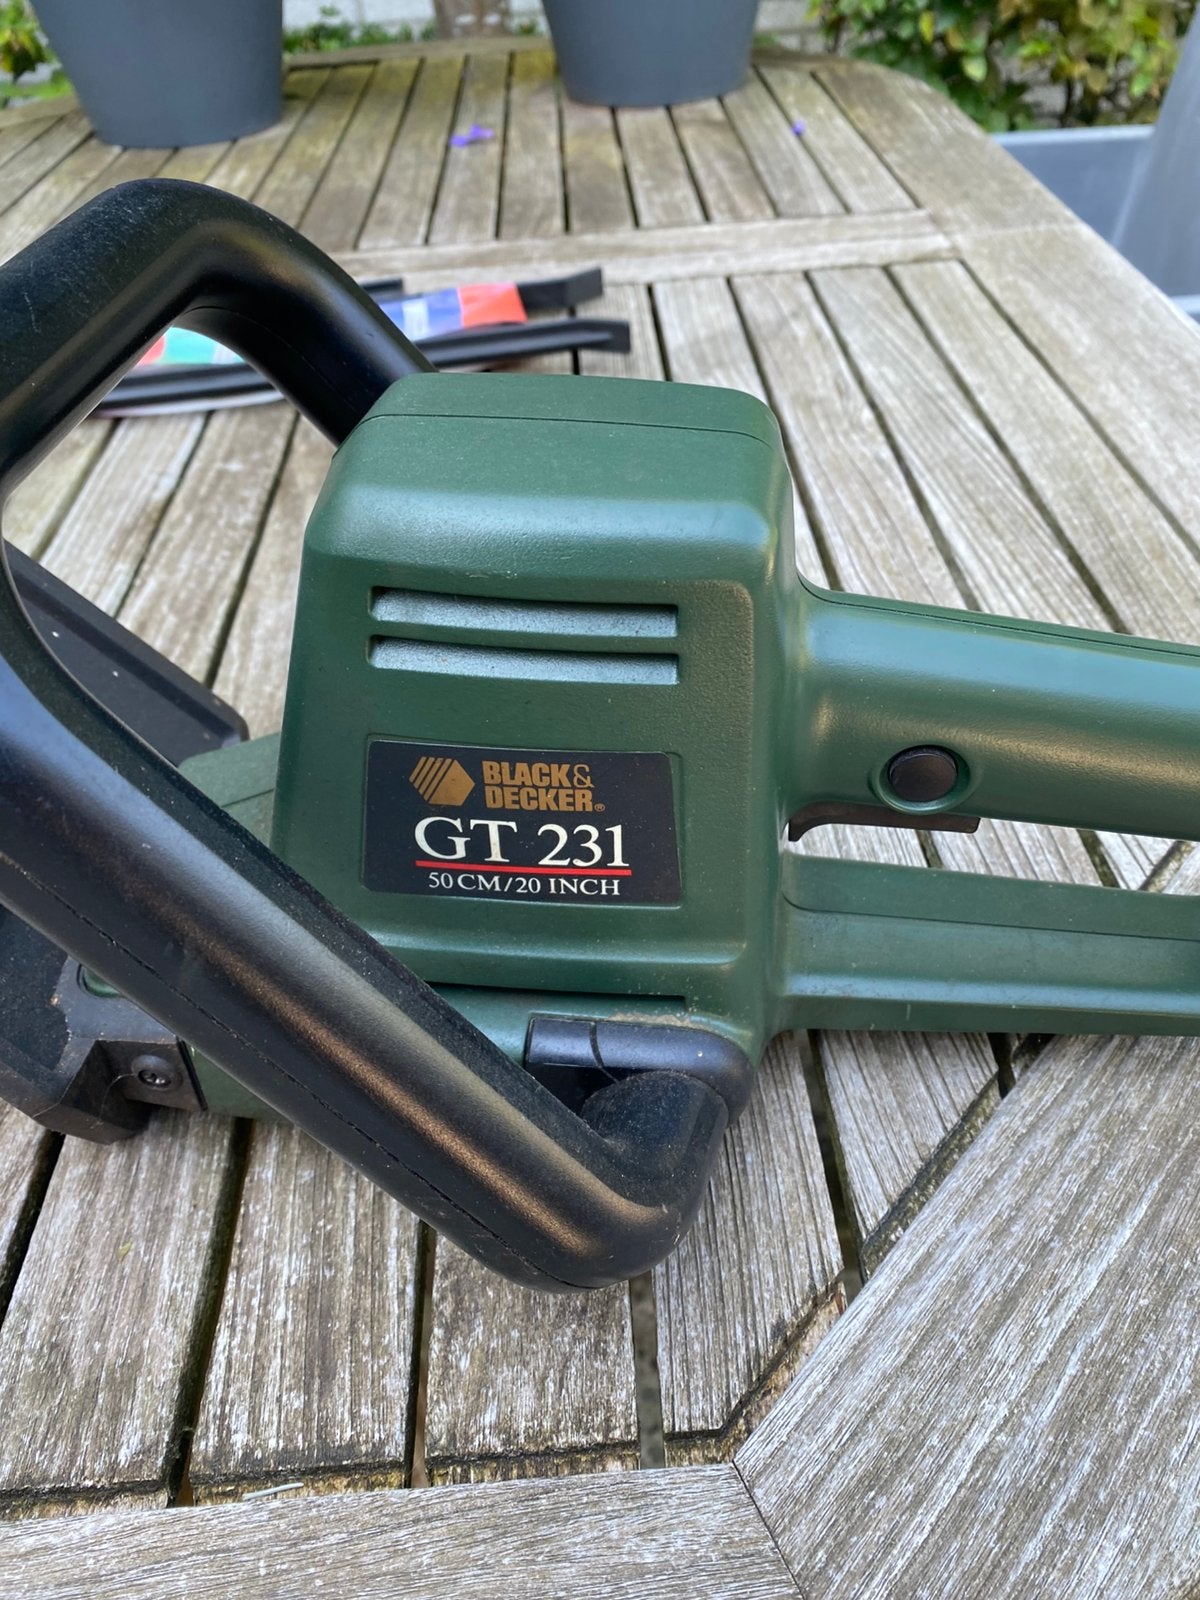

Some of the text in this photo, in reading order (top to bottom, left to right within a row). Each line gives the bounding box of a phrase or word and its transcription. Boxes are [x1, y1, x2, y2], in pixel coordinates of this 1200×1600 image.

[414, 816, 630, 867] GT 231
[428, 872, 621, 896] 50 CM/20 INCH
